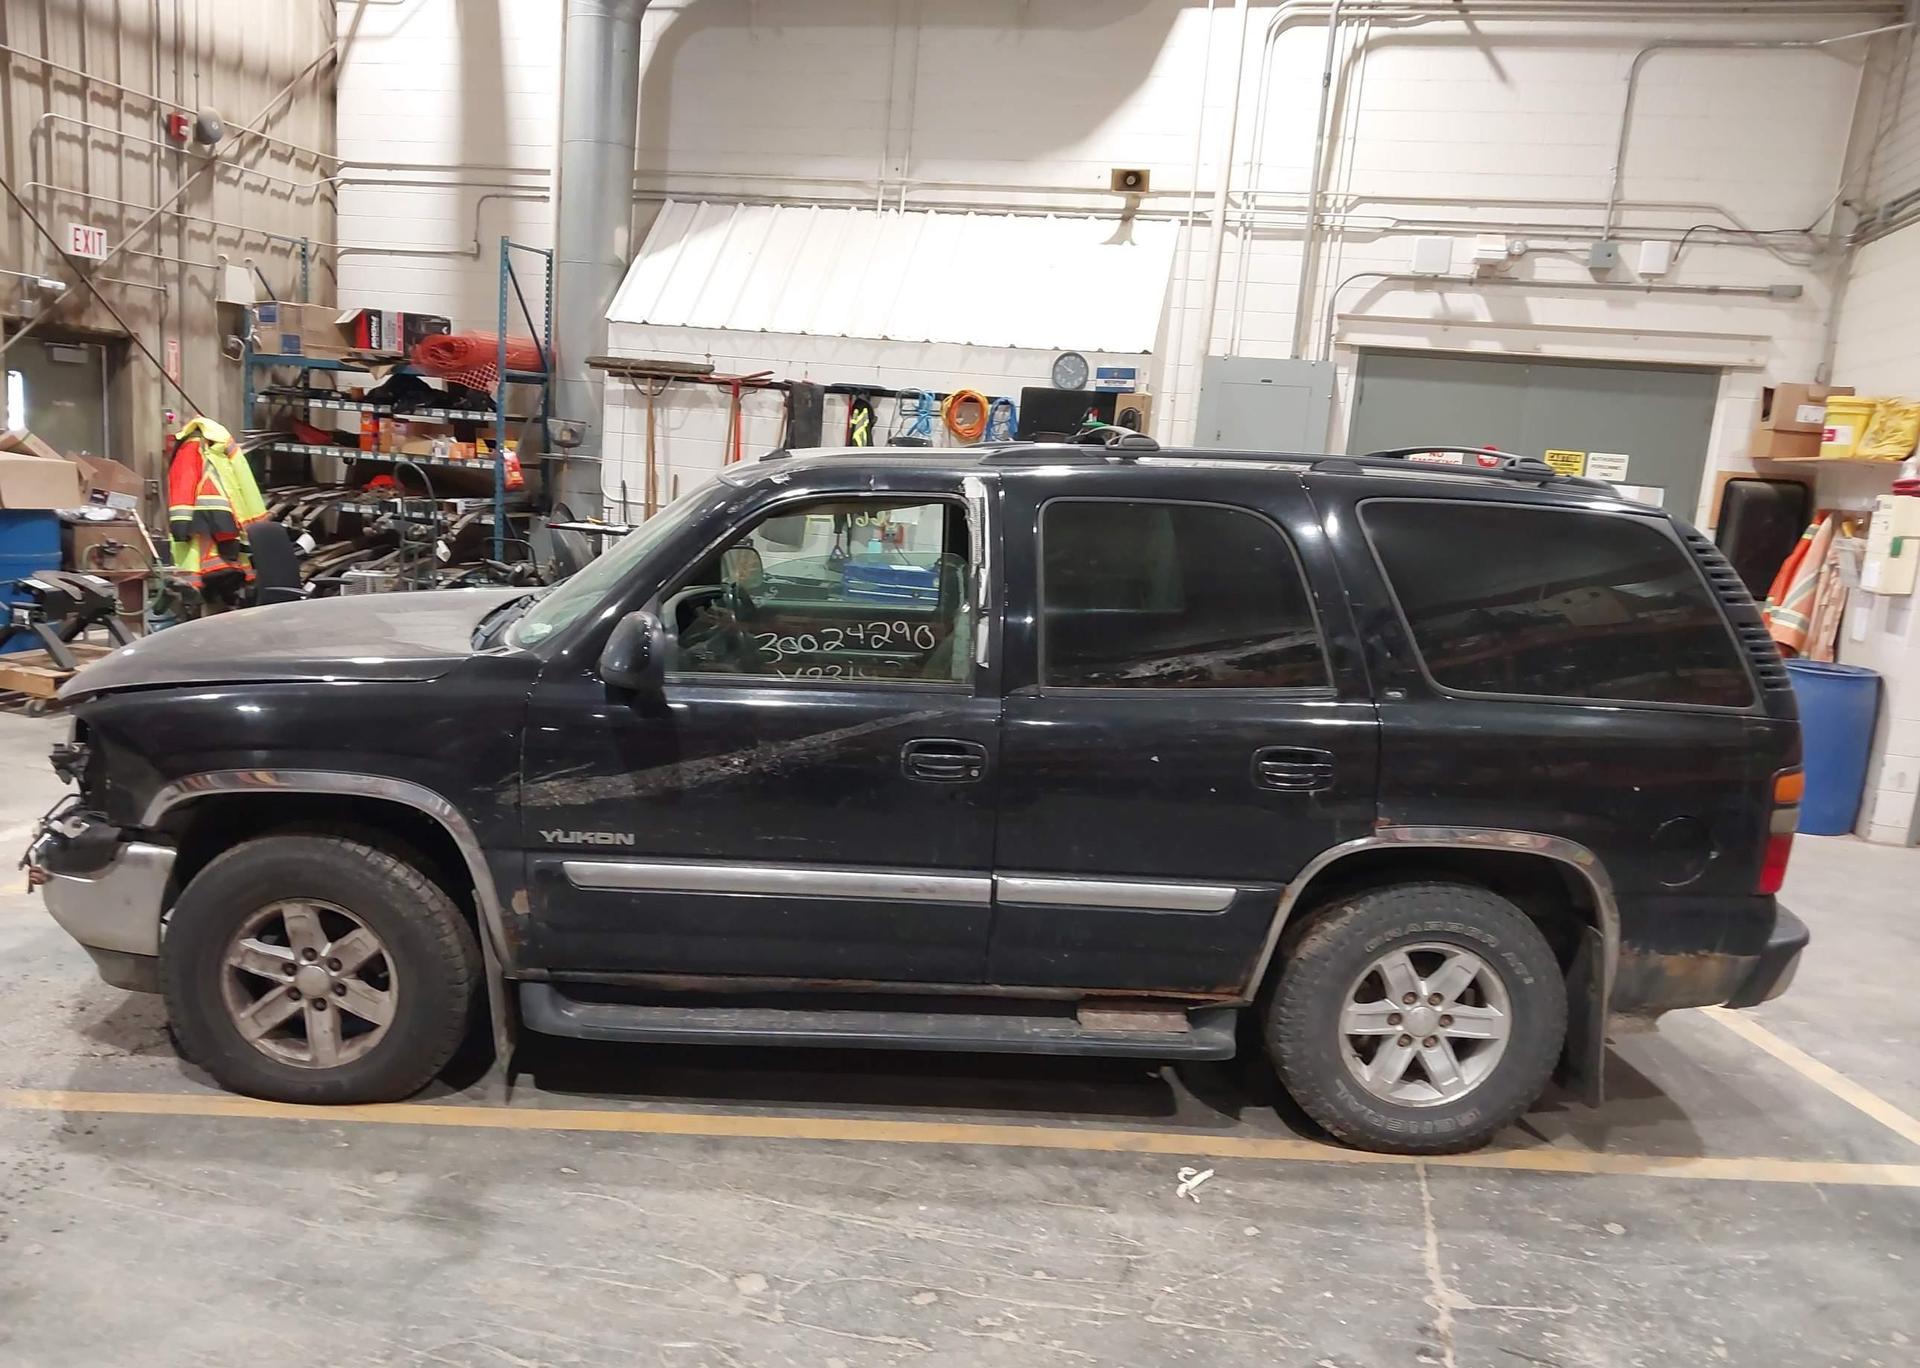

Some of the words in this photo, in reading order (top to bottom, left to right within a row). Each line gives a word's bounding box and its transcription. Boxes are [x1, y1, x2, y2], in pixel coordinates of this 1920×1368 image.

[73, 227, 104, 256] EXIT
[753, 620, 936, 664] 30024290
[539, 828, 635, 846] YUKON
